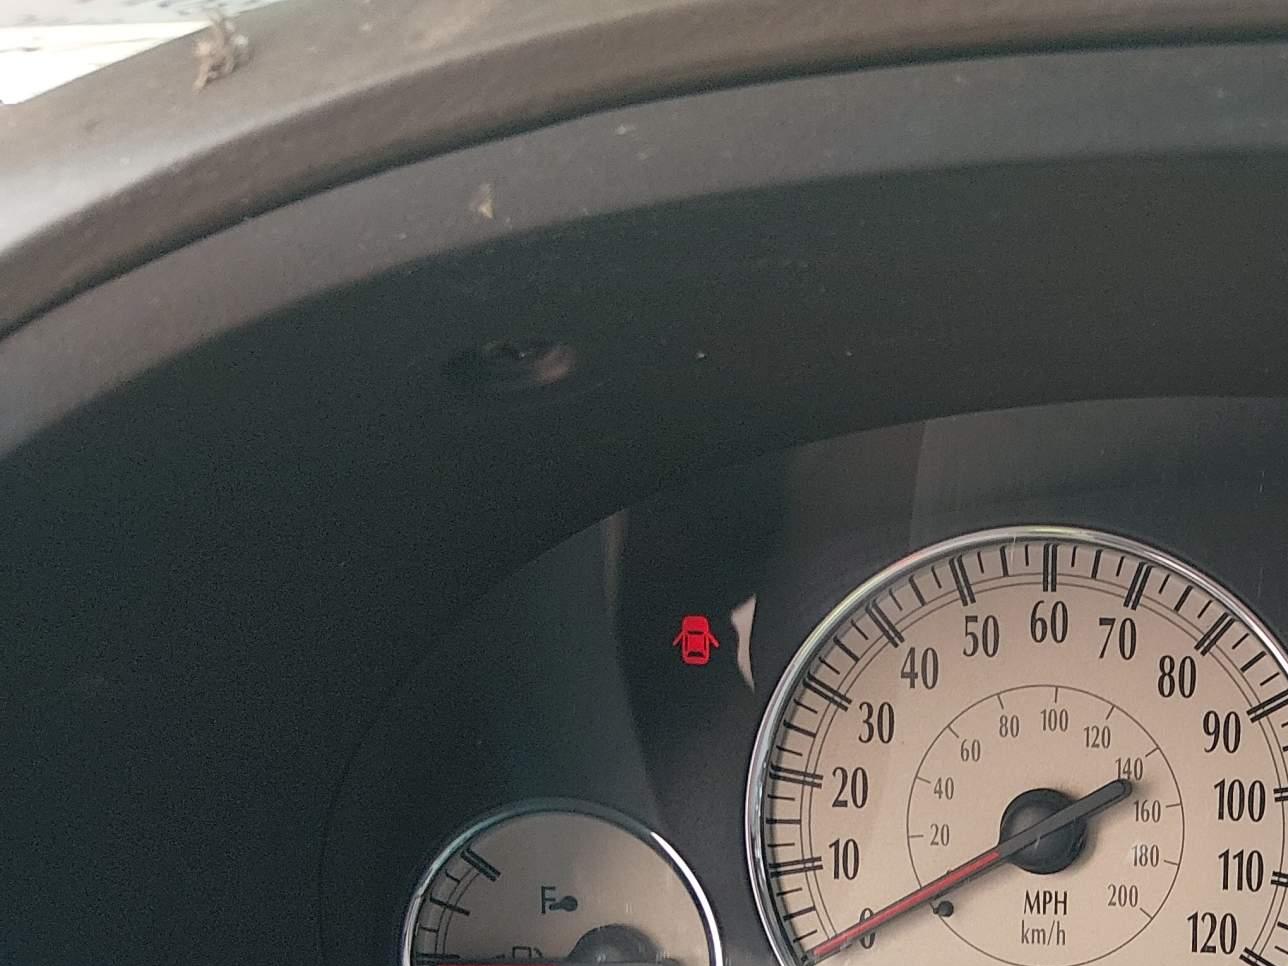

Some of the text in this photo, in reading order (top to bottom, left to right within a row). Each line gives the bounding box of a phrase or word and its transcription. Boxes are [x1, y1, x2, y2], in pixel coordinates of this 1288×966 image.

[963, 615, 999, 658] 50
[1030, 601, 1068, 643] 60
[1098, 617, 1137, 660] 70
[900, 647, 939, 689] 40
[1157, 656, 1197, 698] 80
[858, 702, 895, 744] 30
[999, 715, 1020, 738] 80
[1041, 708, 1069, 731] 100
[1204, 711, 1240, 753] 90
[960, 740, 981, 762] 60
[1084, 726, 1111, 749] 120
[1115, 758, 1144, 782] 140
[833, 766, 868, 808] 20
[933, 777, 954, 799] 40
[1214, 779, 1266, 822] 100
[1134, 800, 1161, 822] 160
[930, 824, 950, 846] 20
[829, 838, 859, 880] 10
[1132, 845, 1159, 867] 180
[1218, 850, 1264, 891] 110
[1024, 890, 1068, 916] MPH
[1108, 885, 1138, 908] 200
[1021, 921, 1066, 946] km/h
[1187, 912, 1237, 954] 120
